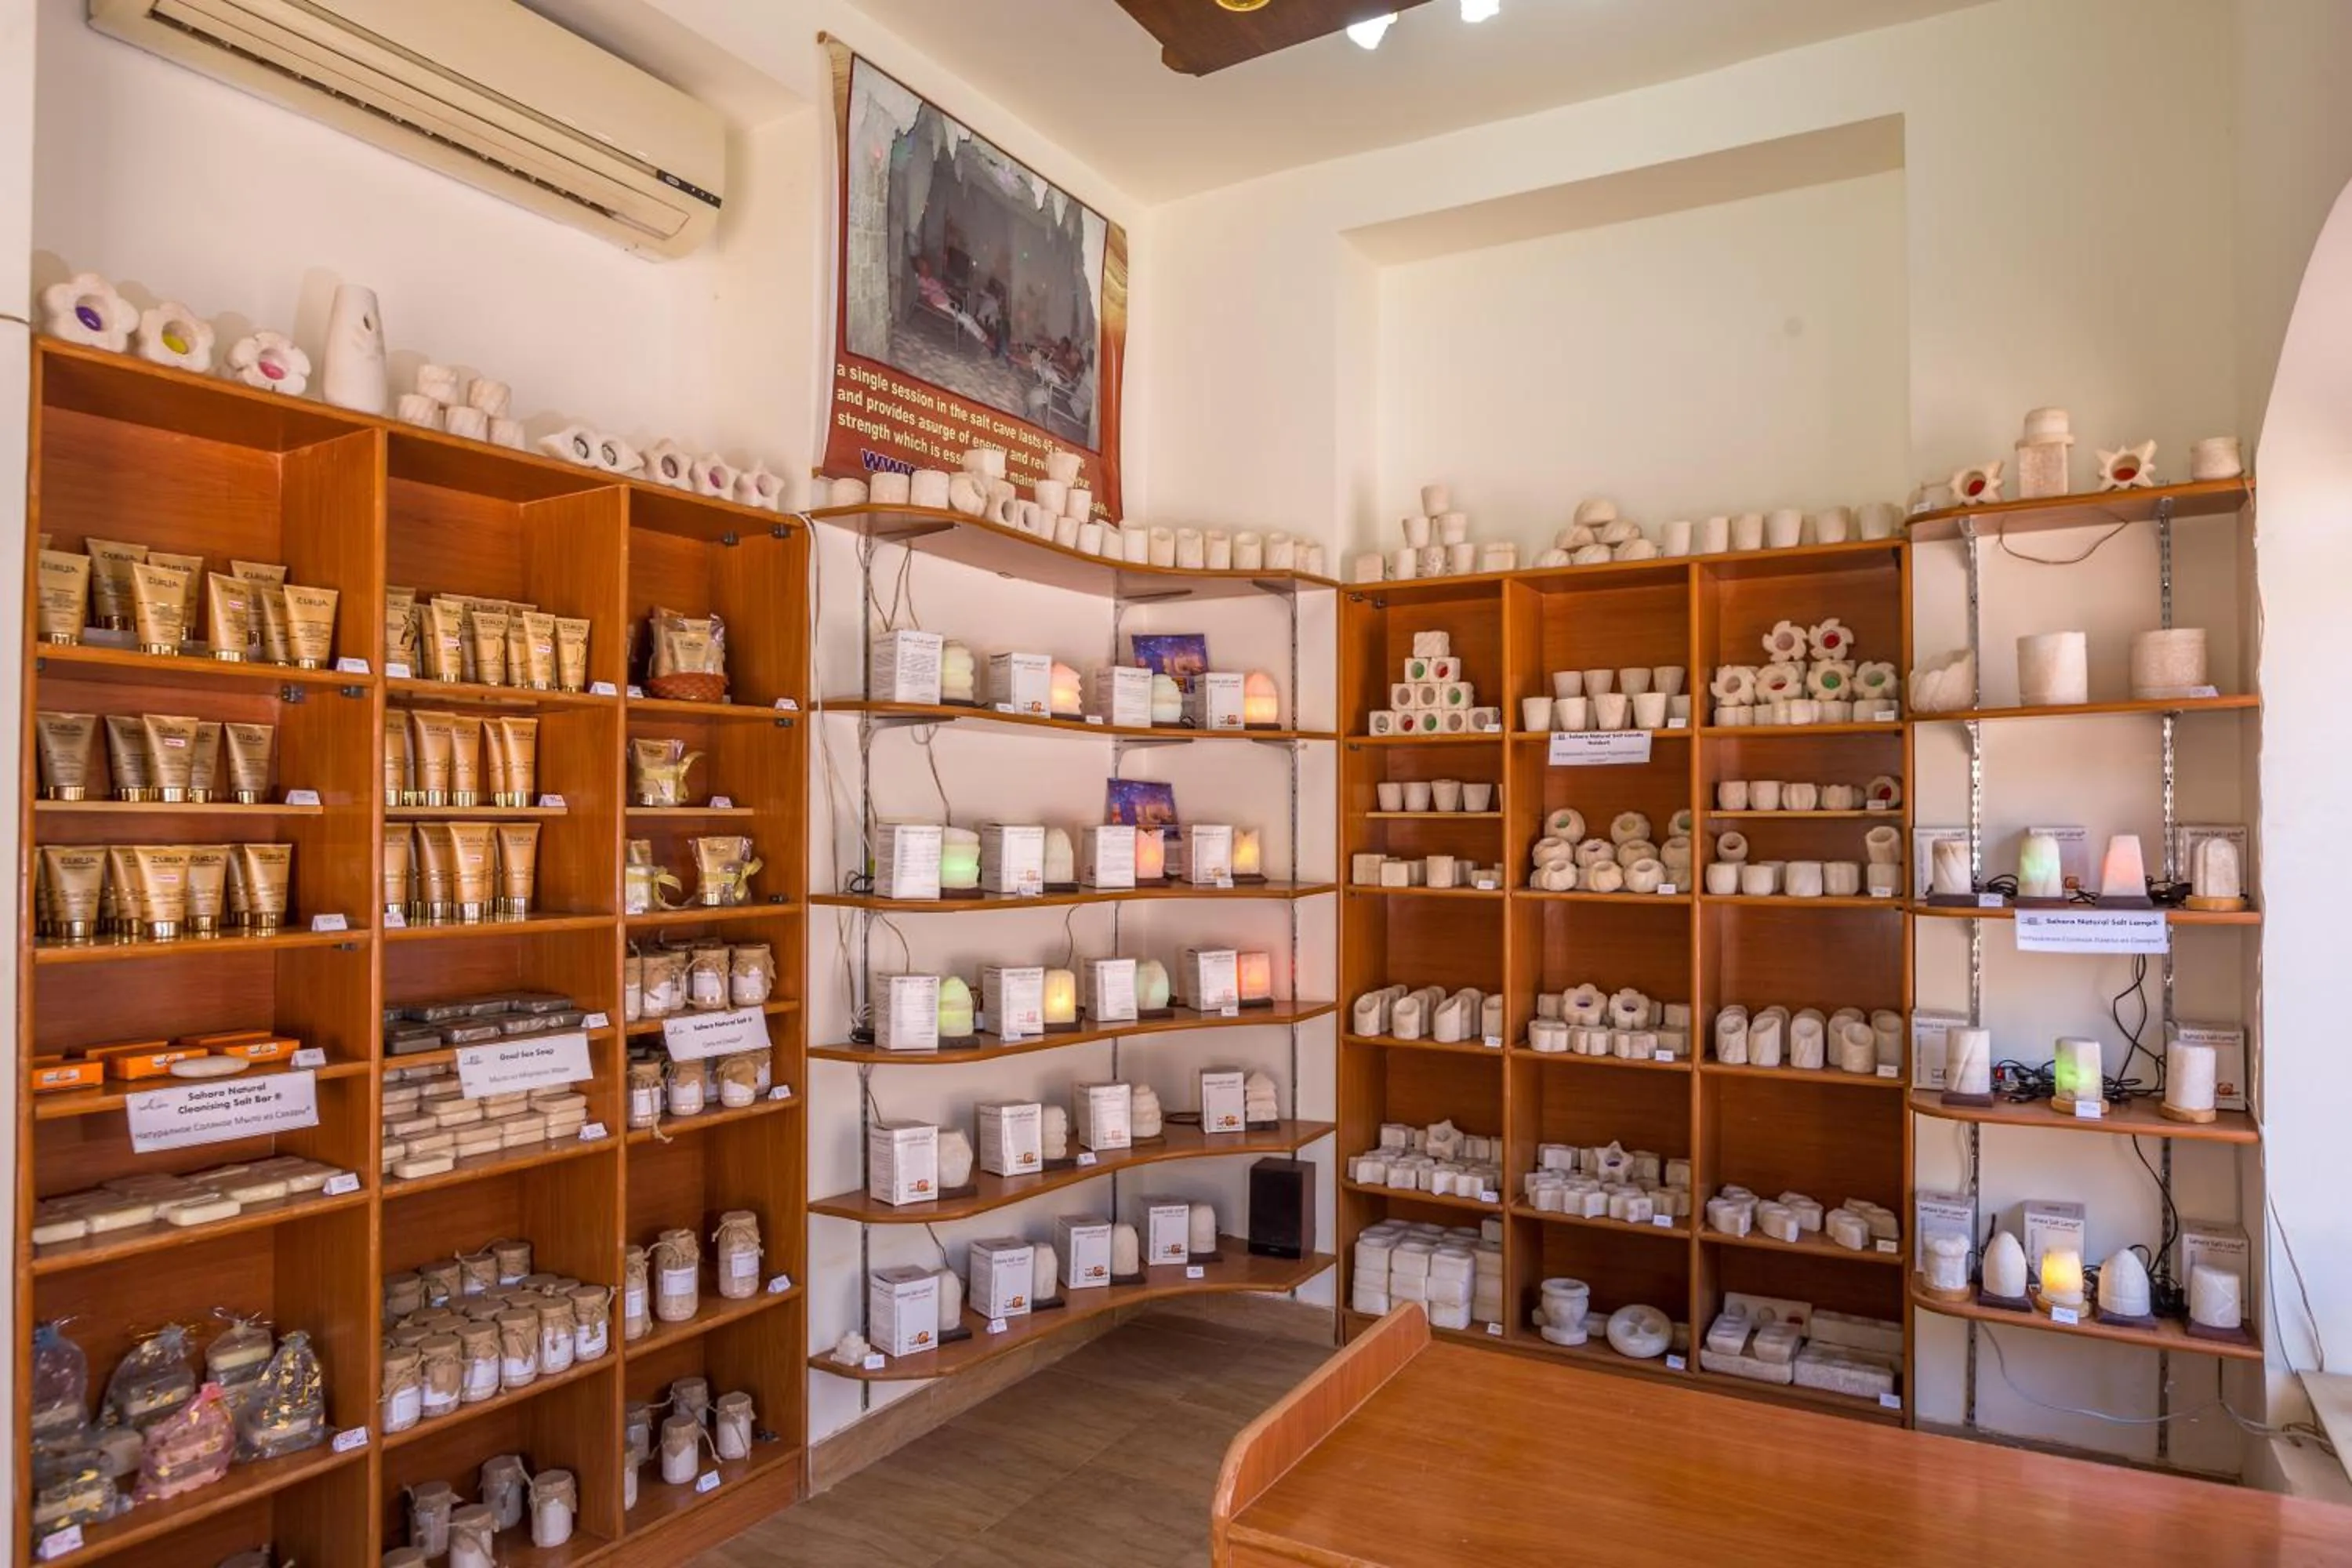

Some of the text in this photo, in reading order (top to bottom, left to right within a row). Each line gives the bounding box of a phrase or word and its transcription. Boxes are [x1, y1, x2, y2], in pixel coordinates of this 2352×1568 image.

[837, 363, 846, 377] a
[849, 366, 888, 391] single
[891, 382, 934, 408] session
[937, 396, 946, 414] in
[949, 402, 967, 421] the
[970, 413, 990, 430] salt
[993, 421, 1016, 439] cave
[1018, 428, 1042, 449] lasts
[837, 387, 863, 406] and
[866, 397, 915, 426] provides
[959, 430, 970, 445] of
[1010, 449, 1028, 465] and
[838, 412, 891, 441] strength
[894, 427, 927, 454] which
[931, 441, 940, 457] is
[228, 1081, 266, 1095] Natural
[234, 1097, 252, 1106] Salt
[255, 1094, 272, 1103] Bar
